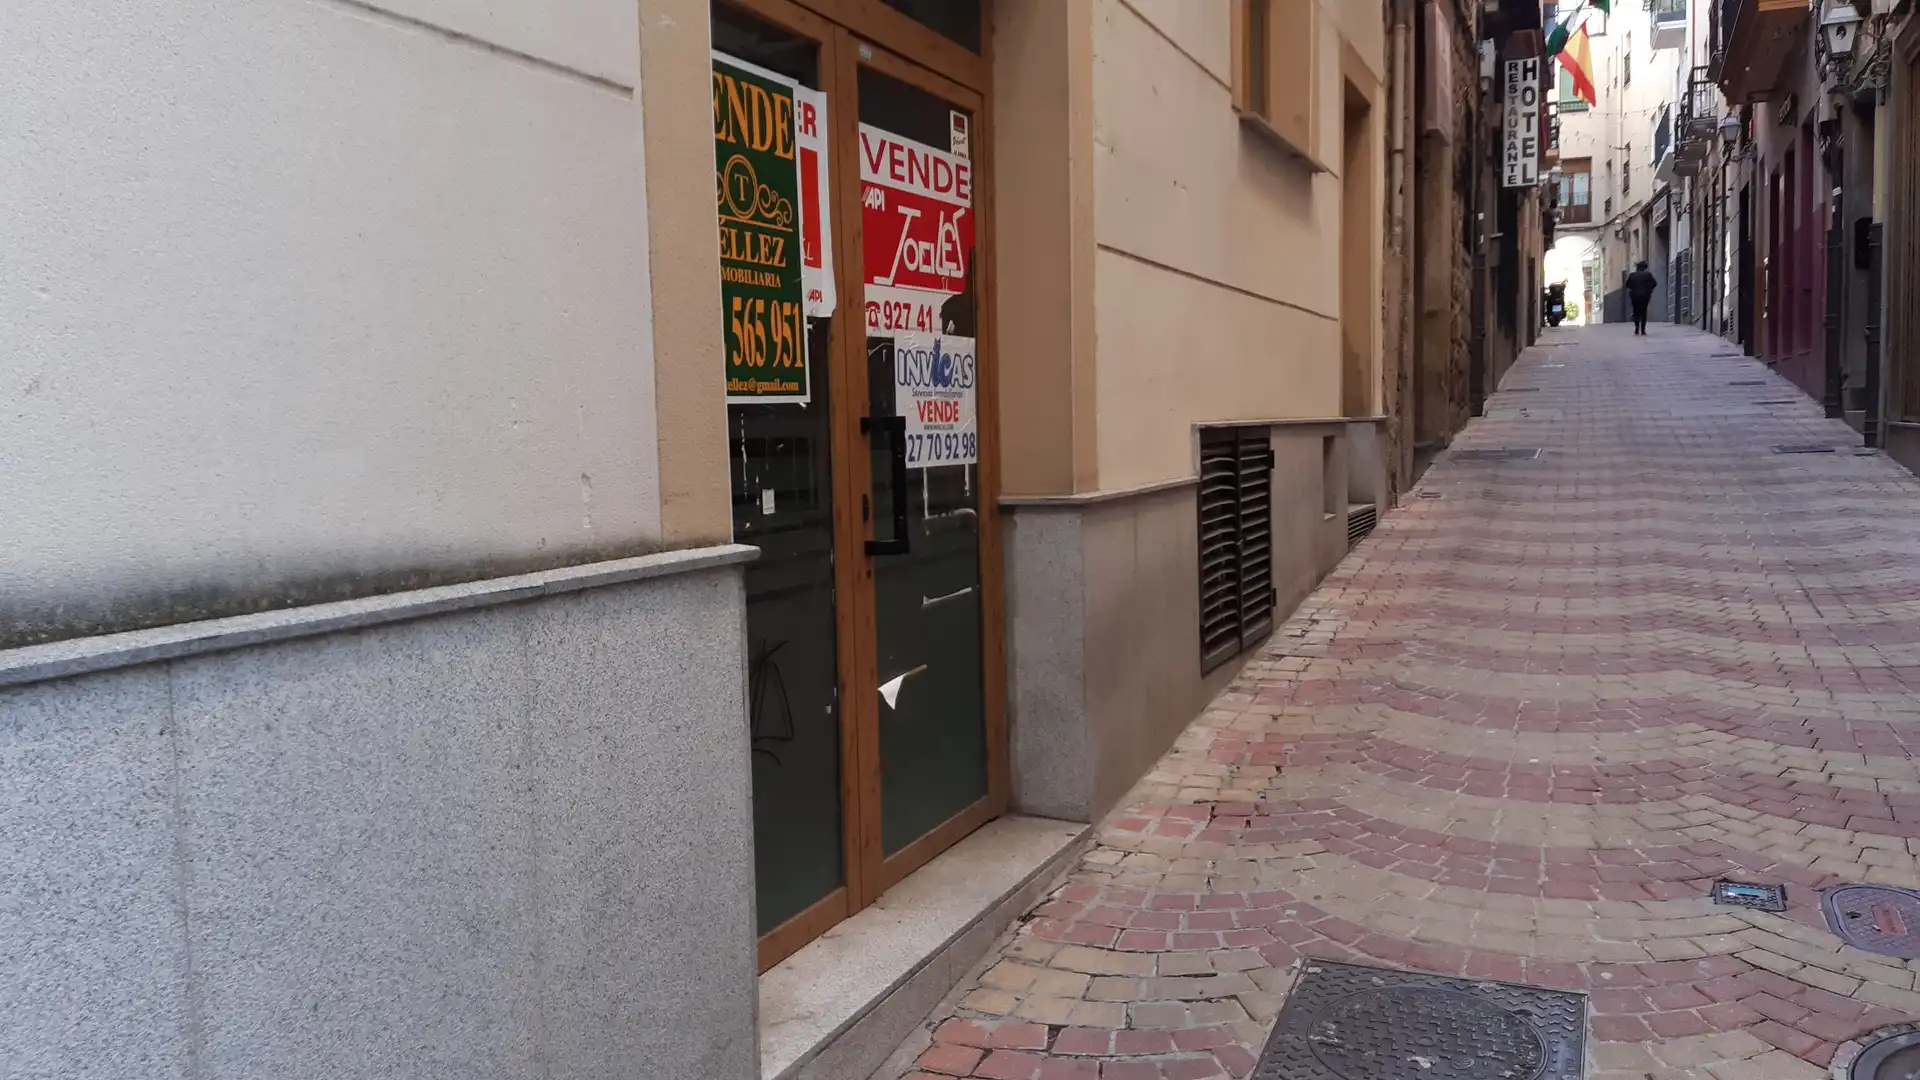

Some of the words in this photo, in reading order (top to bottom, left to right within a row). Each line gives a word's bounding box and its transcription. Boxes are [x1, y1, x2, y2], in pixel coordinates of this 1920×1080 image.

[1507, 62, 1519, 185] RESTAURANTE
[1523, 60, 1537, 184] HOTEL
[860, 131, 969, 200] VENDE
[732, 296, 766, 367] 565
[771, 300, 803, 368] 951
[884, 300, 911, 331] 927
[917, 304, 933, 333] 41
[897, 342, 974, 388] INVICAS
[917, 400, 959, 422] VENDE
[908, 434, 924, 462] 27
[926, 433, 942, 461] 70
[945, 432, 960, 460] 92
[962, 432, 976, 459] 98
